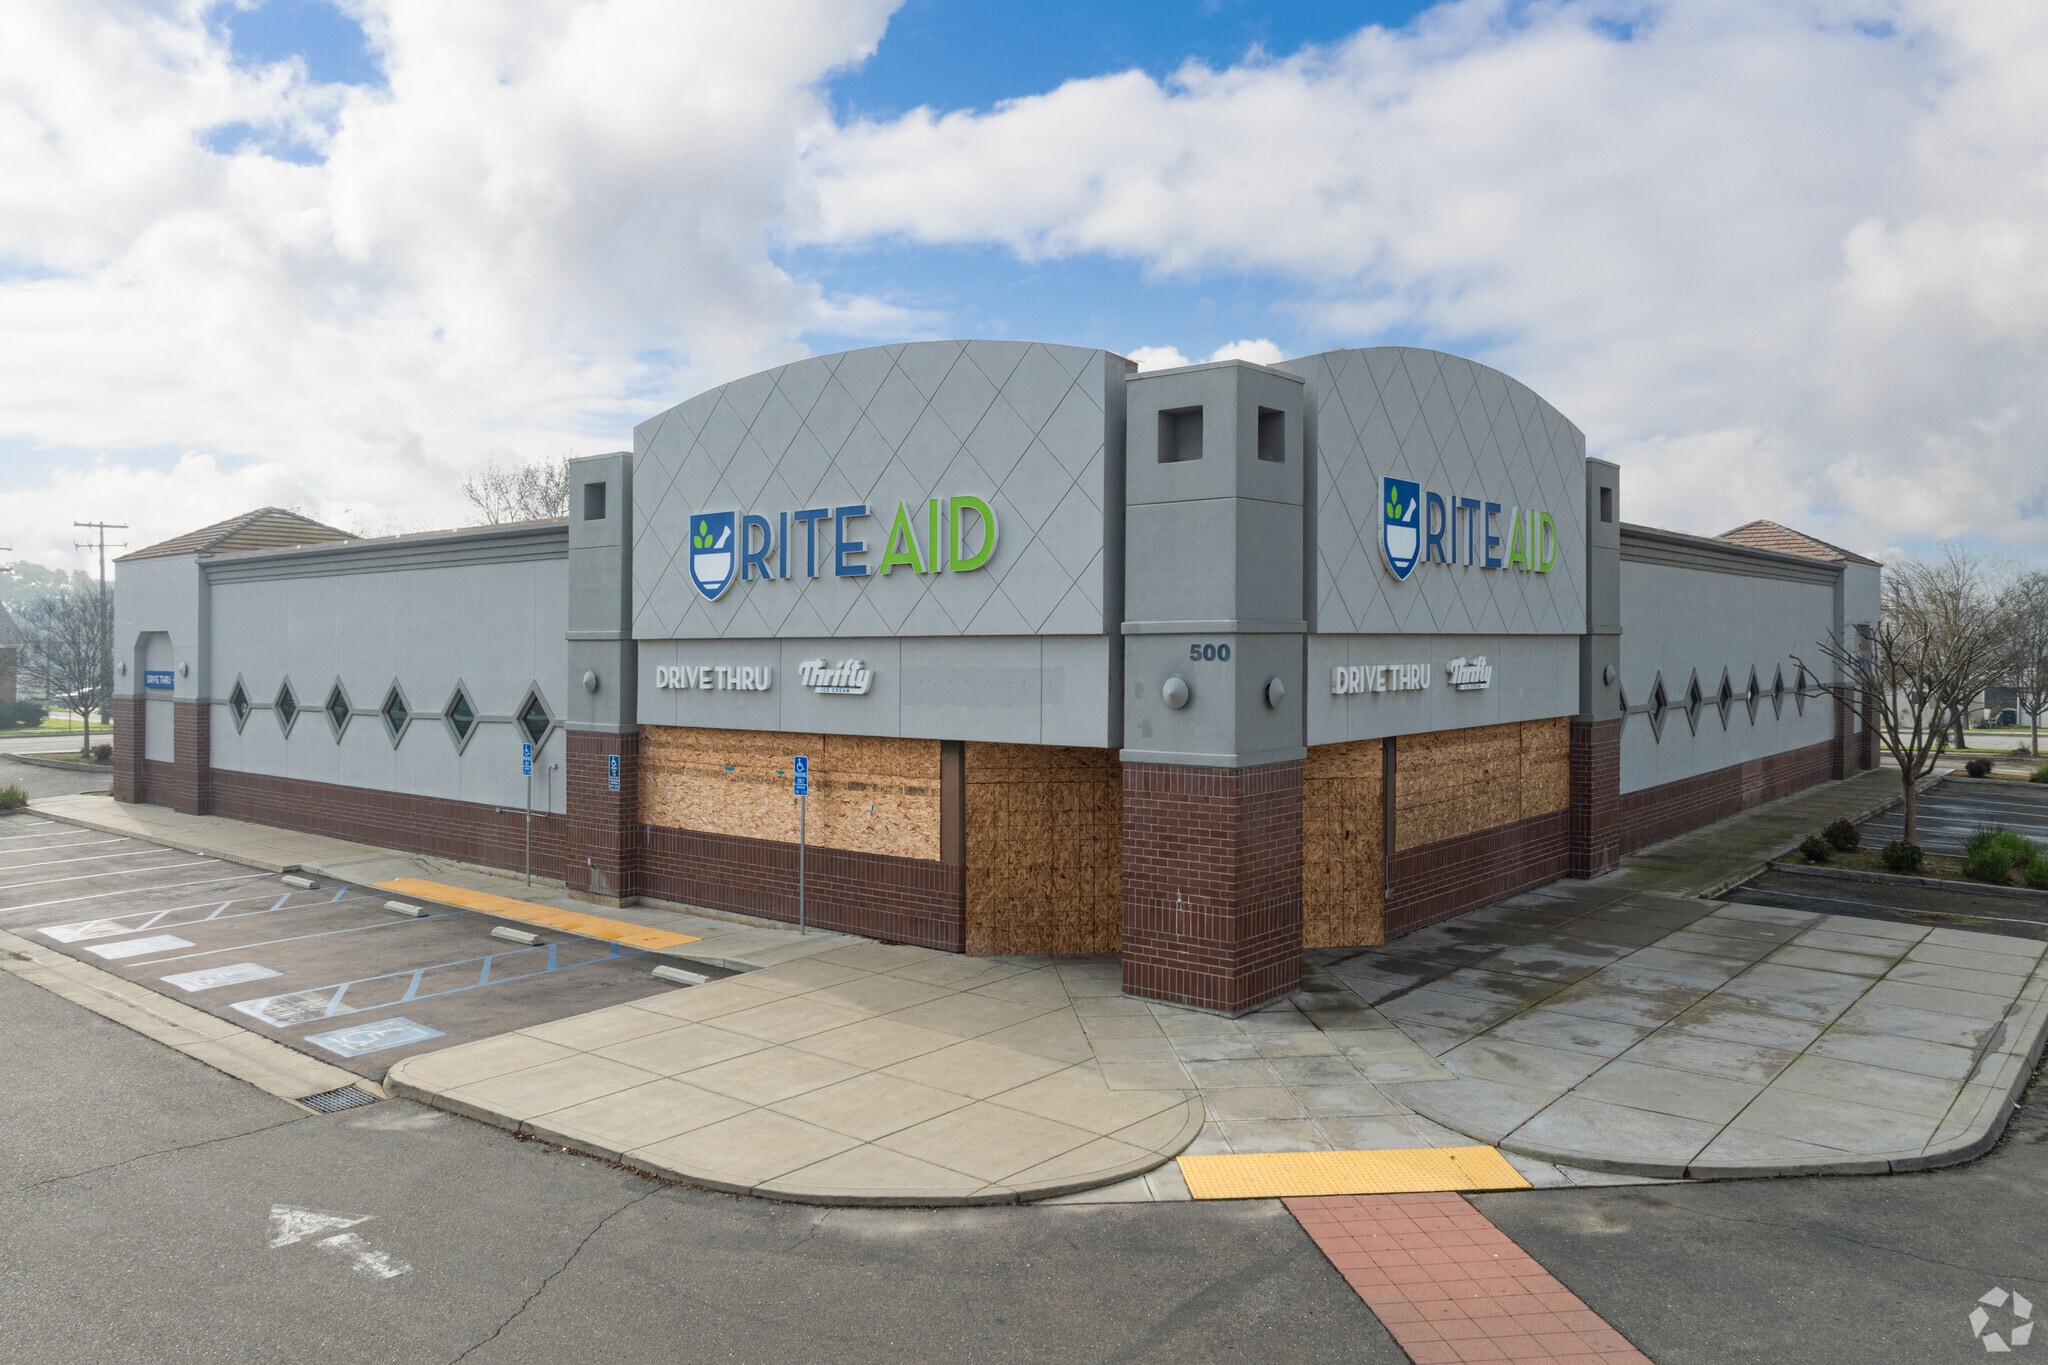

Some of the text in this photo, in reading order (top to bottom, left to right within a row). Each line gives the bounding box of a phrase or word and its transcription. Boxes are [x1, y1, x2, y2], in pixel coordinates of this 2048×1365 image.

[741, 496, 999, 581] RITE AID
[1420, 491, 1557, 573] RITE AID
[1189, 643, 1231, 662] 500
[656, 665, 772, 692] DRIVE THRU
[799, 658, 874, 694] Thrifty
[1332, 663, 1431, 694] DRIVE THRU
[1445, 655, 1492, 688] Thrifty
